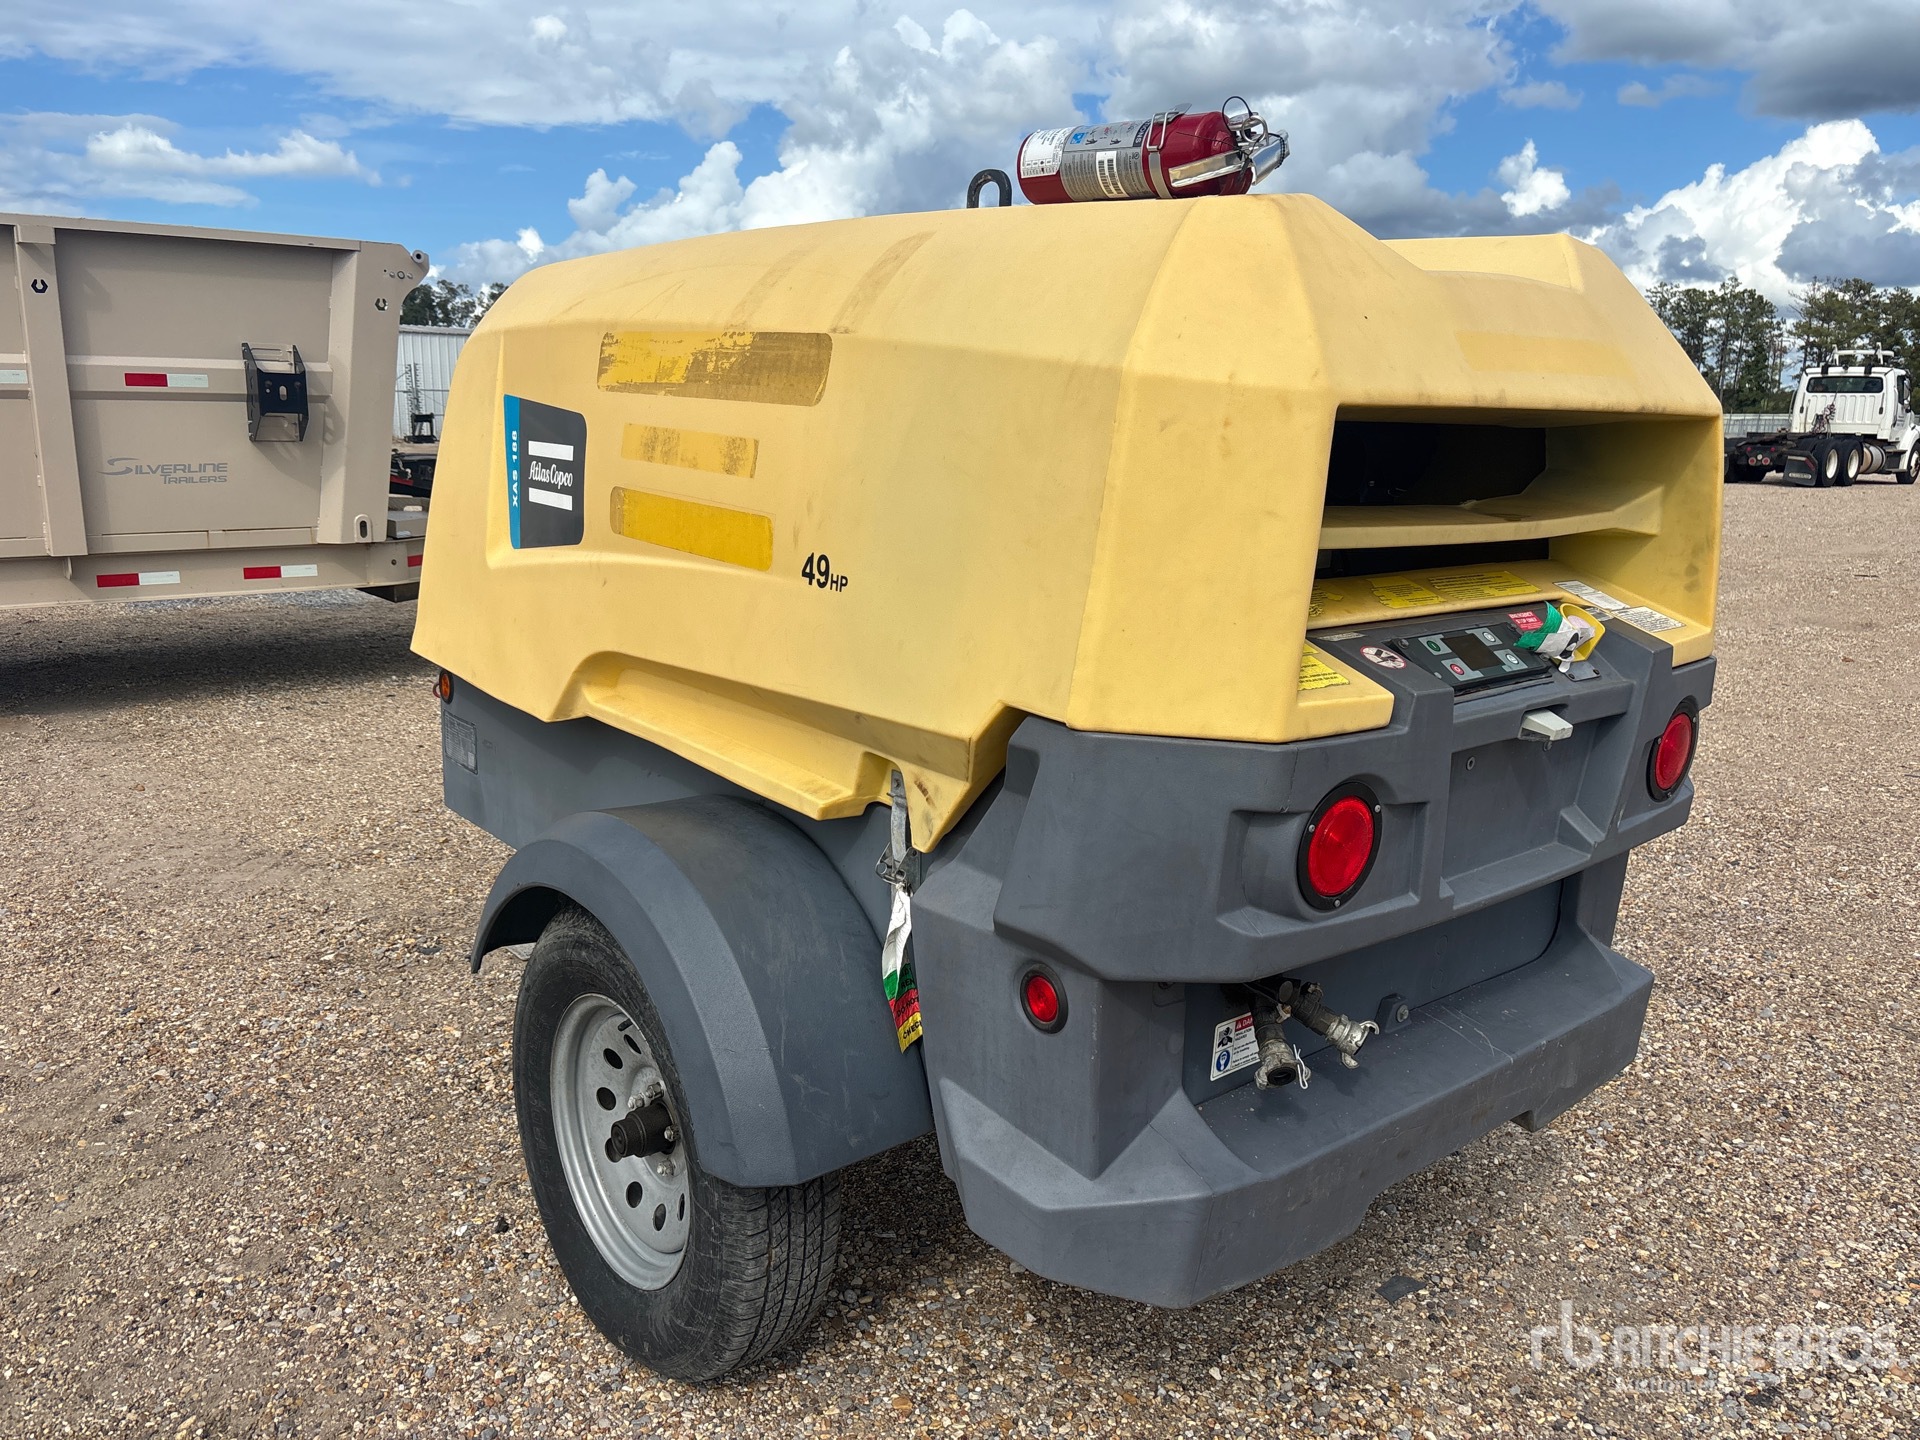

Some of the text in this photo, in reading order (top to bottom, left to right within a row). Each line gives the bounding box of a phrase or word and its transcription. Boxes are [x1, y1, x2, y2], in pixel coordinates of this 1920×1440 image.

[97, 458, 228, 476] SILVERLINE
[528, 460, 573, 490] Atlas Copco
[160, 474, 228, 485] TRAILERS
[902, 1020, 922, 1040] CHEC
